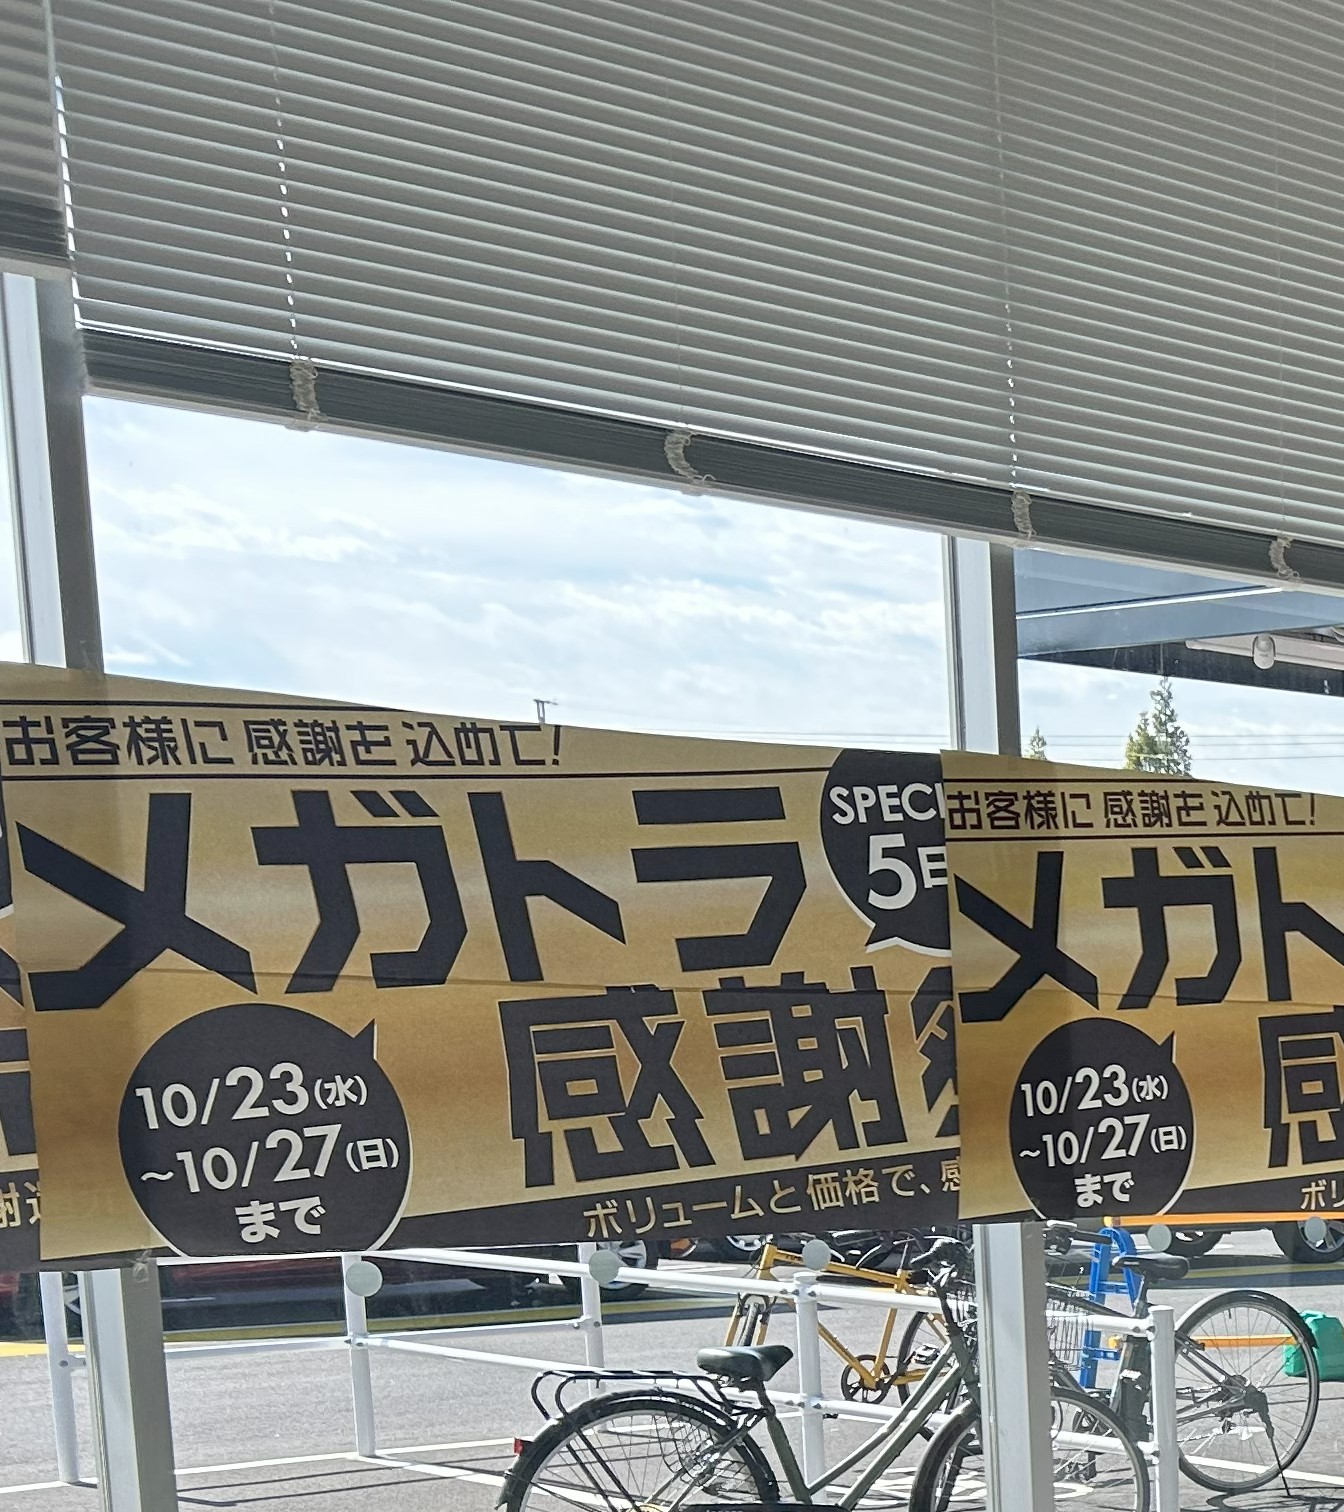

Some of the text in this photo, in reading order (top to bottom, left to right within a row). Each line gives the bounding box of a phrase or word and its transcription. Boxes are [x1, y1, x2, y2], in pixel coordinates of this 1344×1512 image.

[16, 787, 807, 1012] メガトラ
[135, 1061, 368, 1130] 10/23(水)
[1020, 1065, 1169, 1118] 10/23(水)
[1074, 1173, 1135, 1207] まで
[234, 1201, 325, 1245] まで
